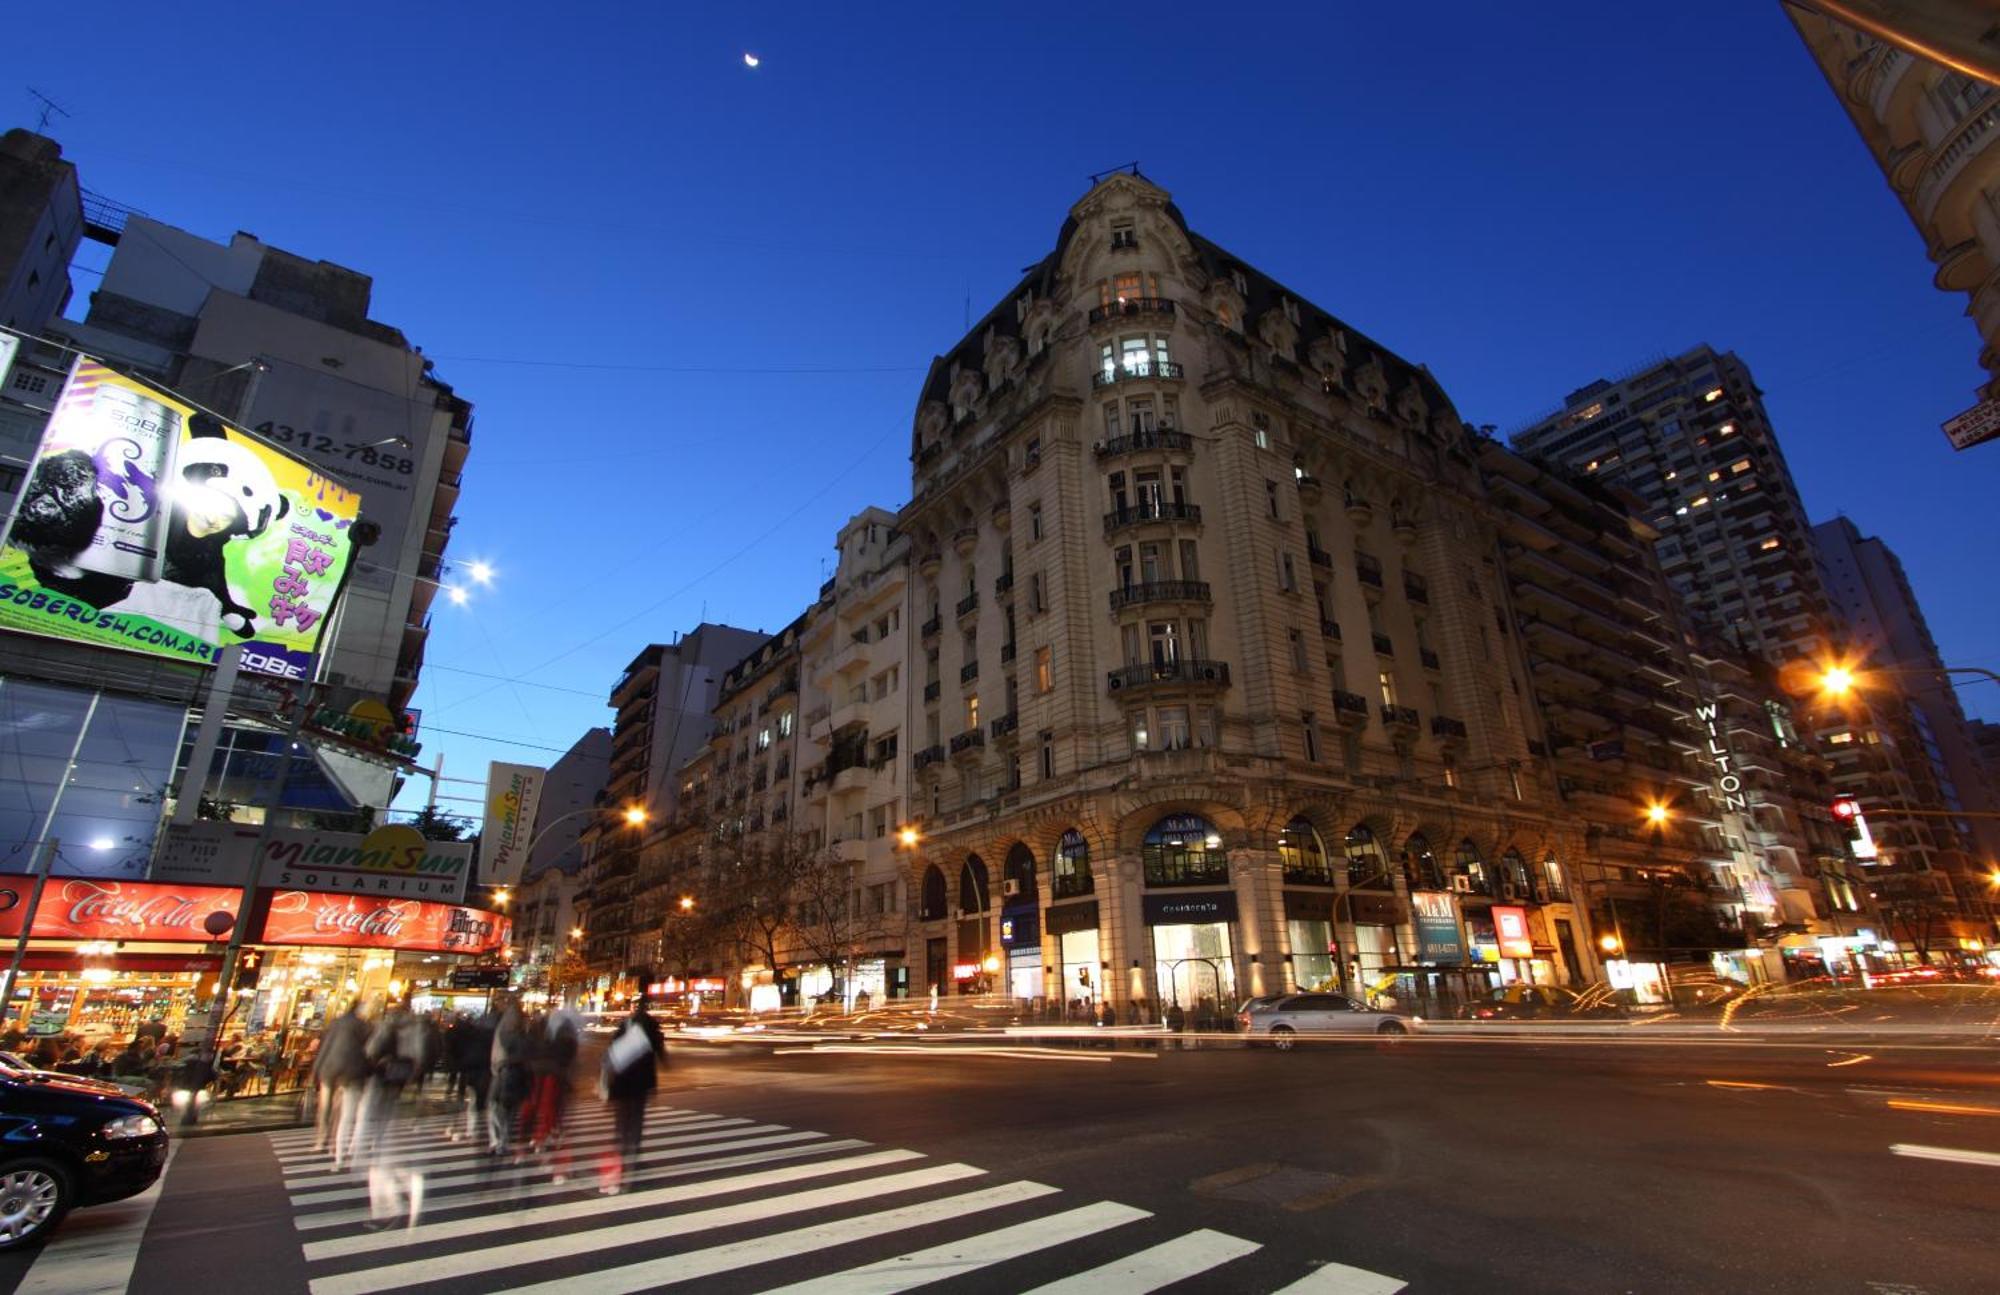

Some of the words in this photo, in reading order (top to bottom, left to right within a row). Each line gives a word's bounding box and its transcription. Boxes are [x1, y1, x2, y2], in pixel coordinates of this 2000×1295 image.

[254, 421, 414, 475] 4312-7858
[0, 584, 211, 658] SOBERUSH.COM.AR
[1696, 703, 1746, 811] WILTON
[280, 872, 455, 895] SOLARIUM
